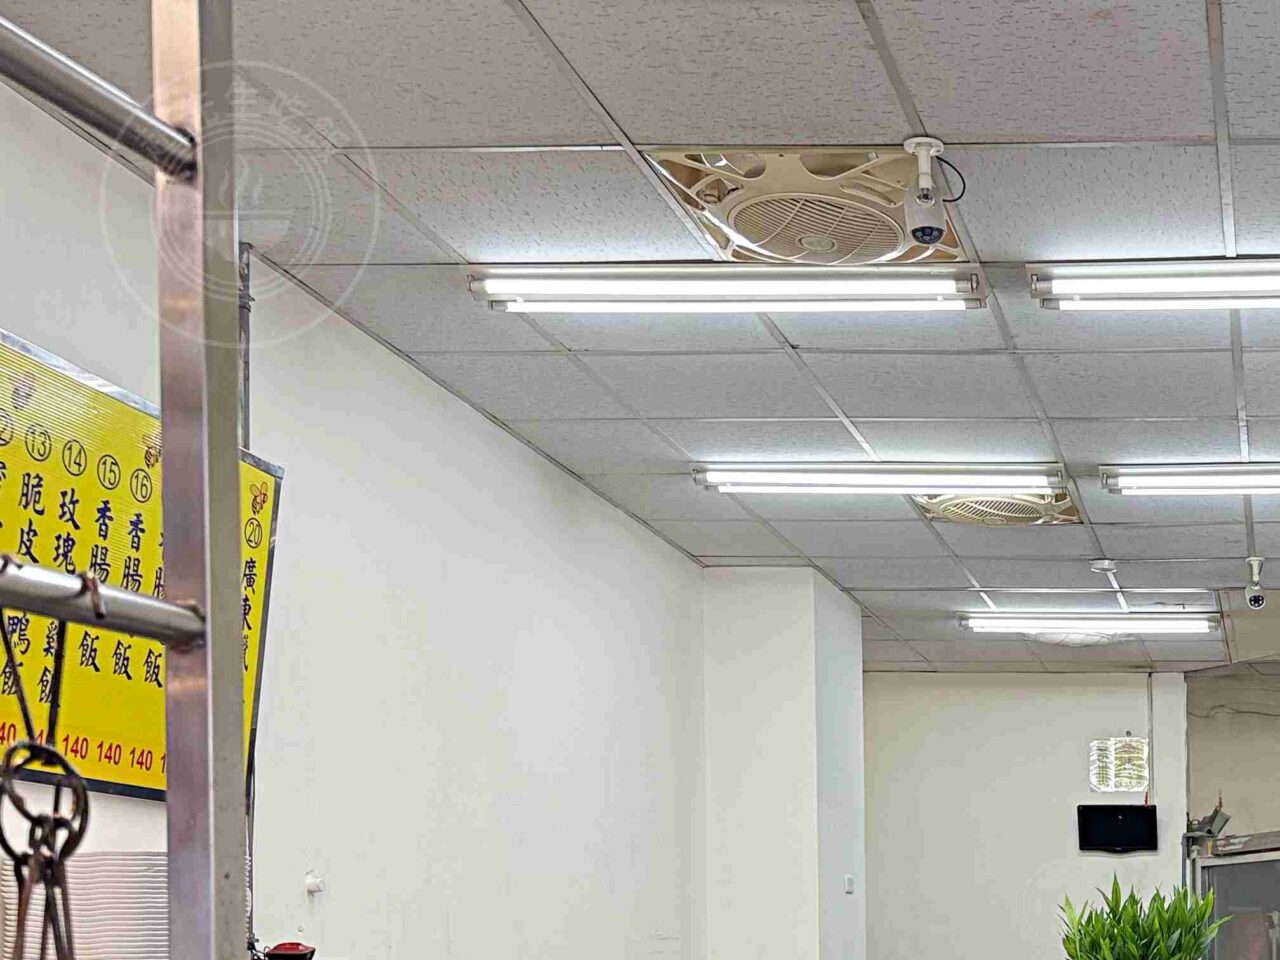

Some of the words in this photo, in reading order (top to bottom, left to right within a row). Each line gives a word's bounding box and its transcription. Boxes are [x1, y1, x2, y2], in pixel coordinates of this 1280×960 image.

[78, 500, 114, 673] 香腸飯
[112, 513, 146, 681] 香腸飯
[62, 734, 89, 760] 140
[97, 741, 122, 766] 140
[129, 747, 153, 771] 140
